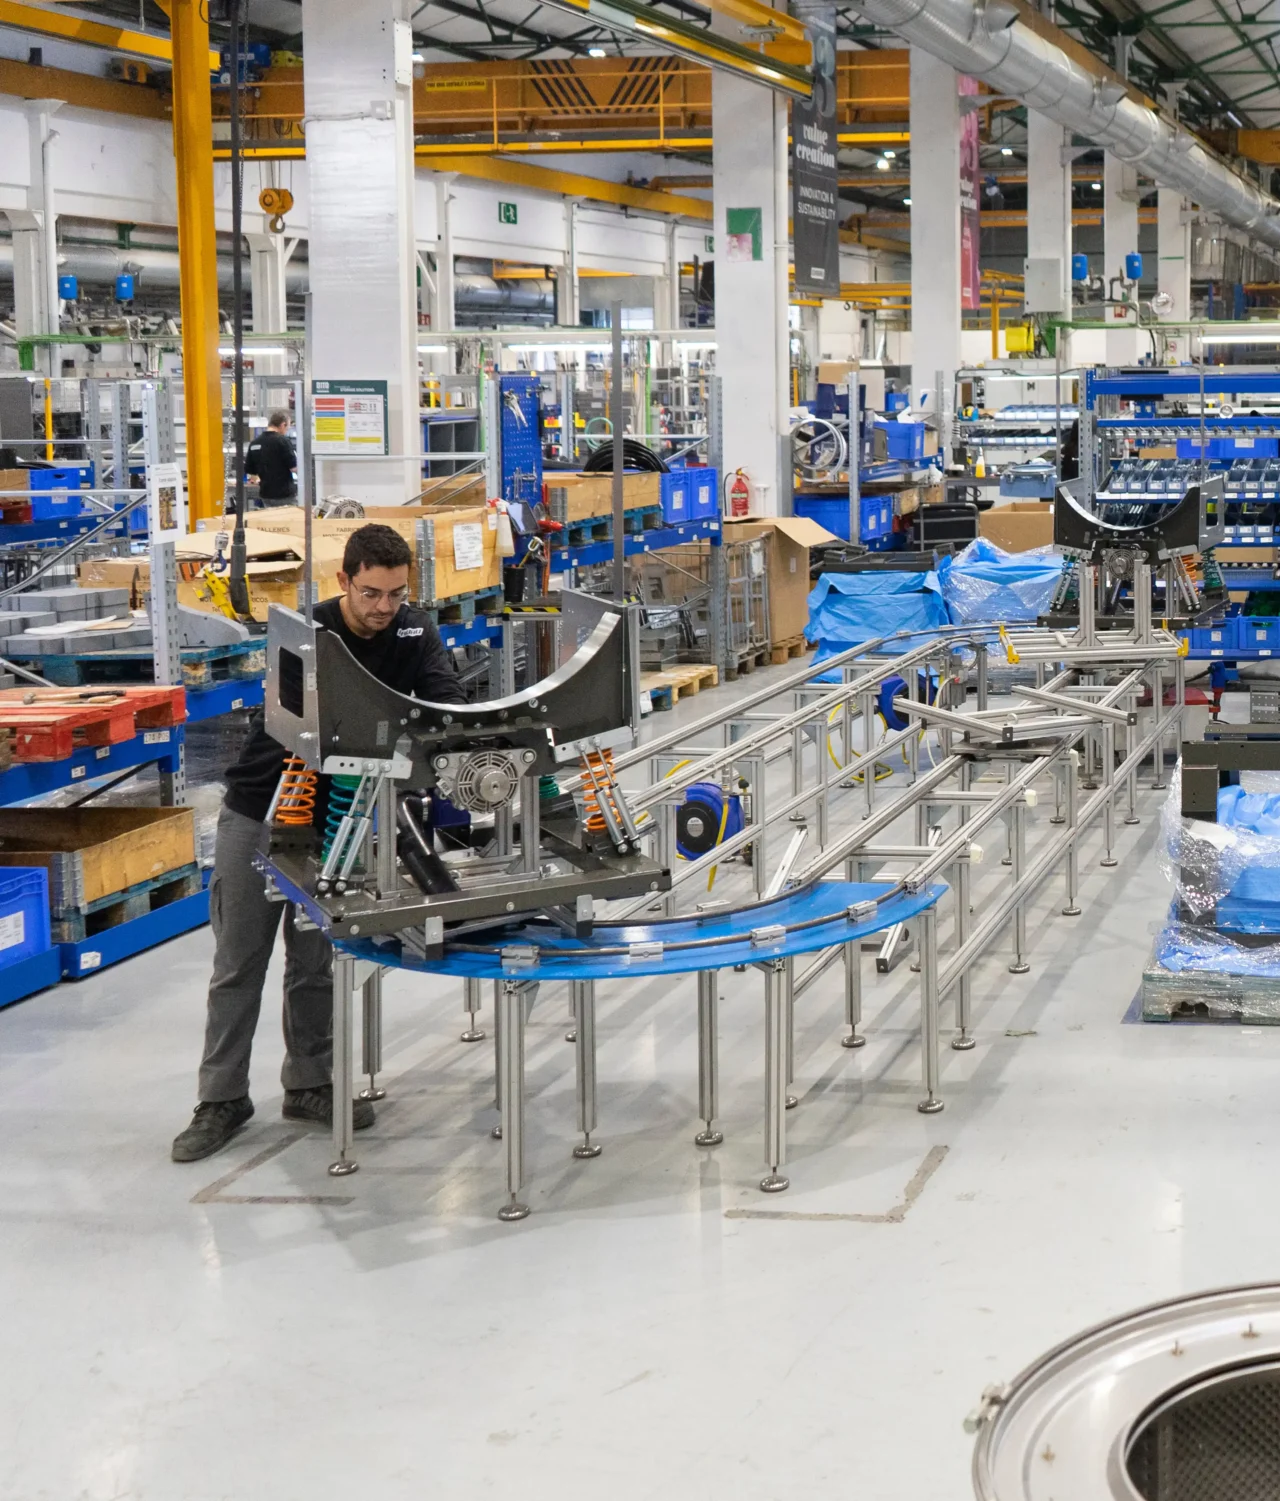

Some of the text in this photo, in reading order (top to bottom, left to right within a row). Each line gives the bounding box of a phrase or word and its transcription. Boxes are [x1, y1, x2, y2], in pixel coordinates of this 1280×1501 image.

[803, 121, 828, 147] value
[795, 143, 836, 169] creation
[799, 185, 830, 204] INNOVATION
[797, 201, 836, 220] SUSTAINABILITY
